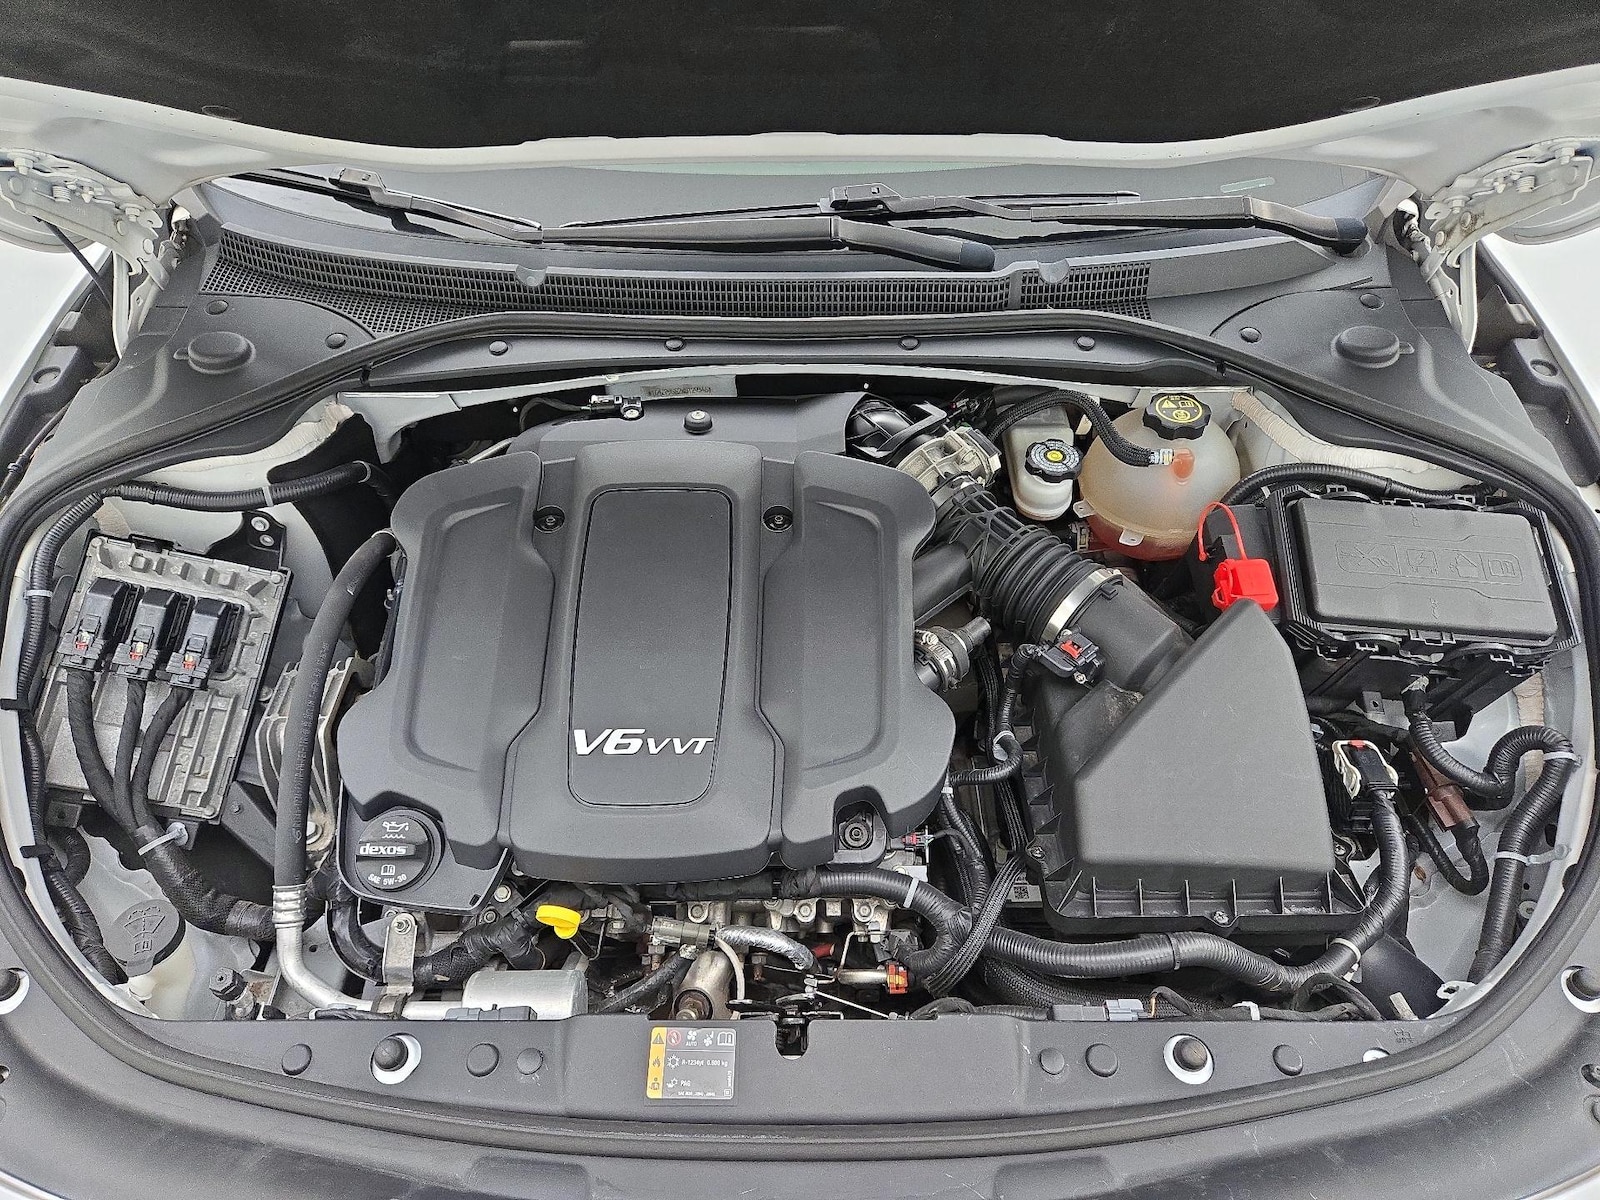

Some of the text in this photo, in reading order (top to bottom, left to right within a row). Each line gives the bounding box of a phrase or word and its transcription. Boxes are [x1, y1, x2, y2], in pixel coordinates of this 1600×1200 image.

[573, 729, 714, 755] V6 VVT
[359, 843, 407, 855] dexos
[368, 873, 407, 885] SAE 5W-30
